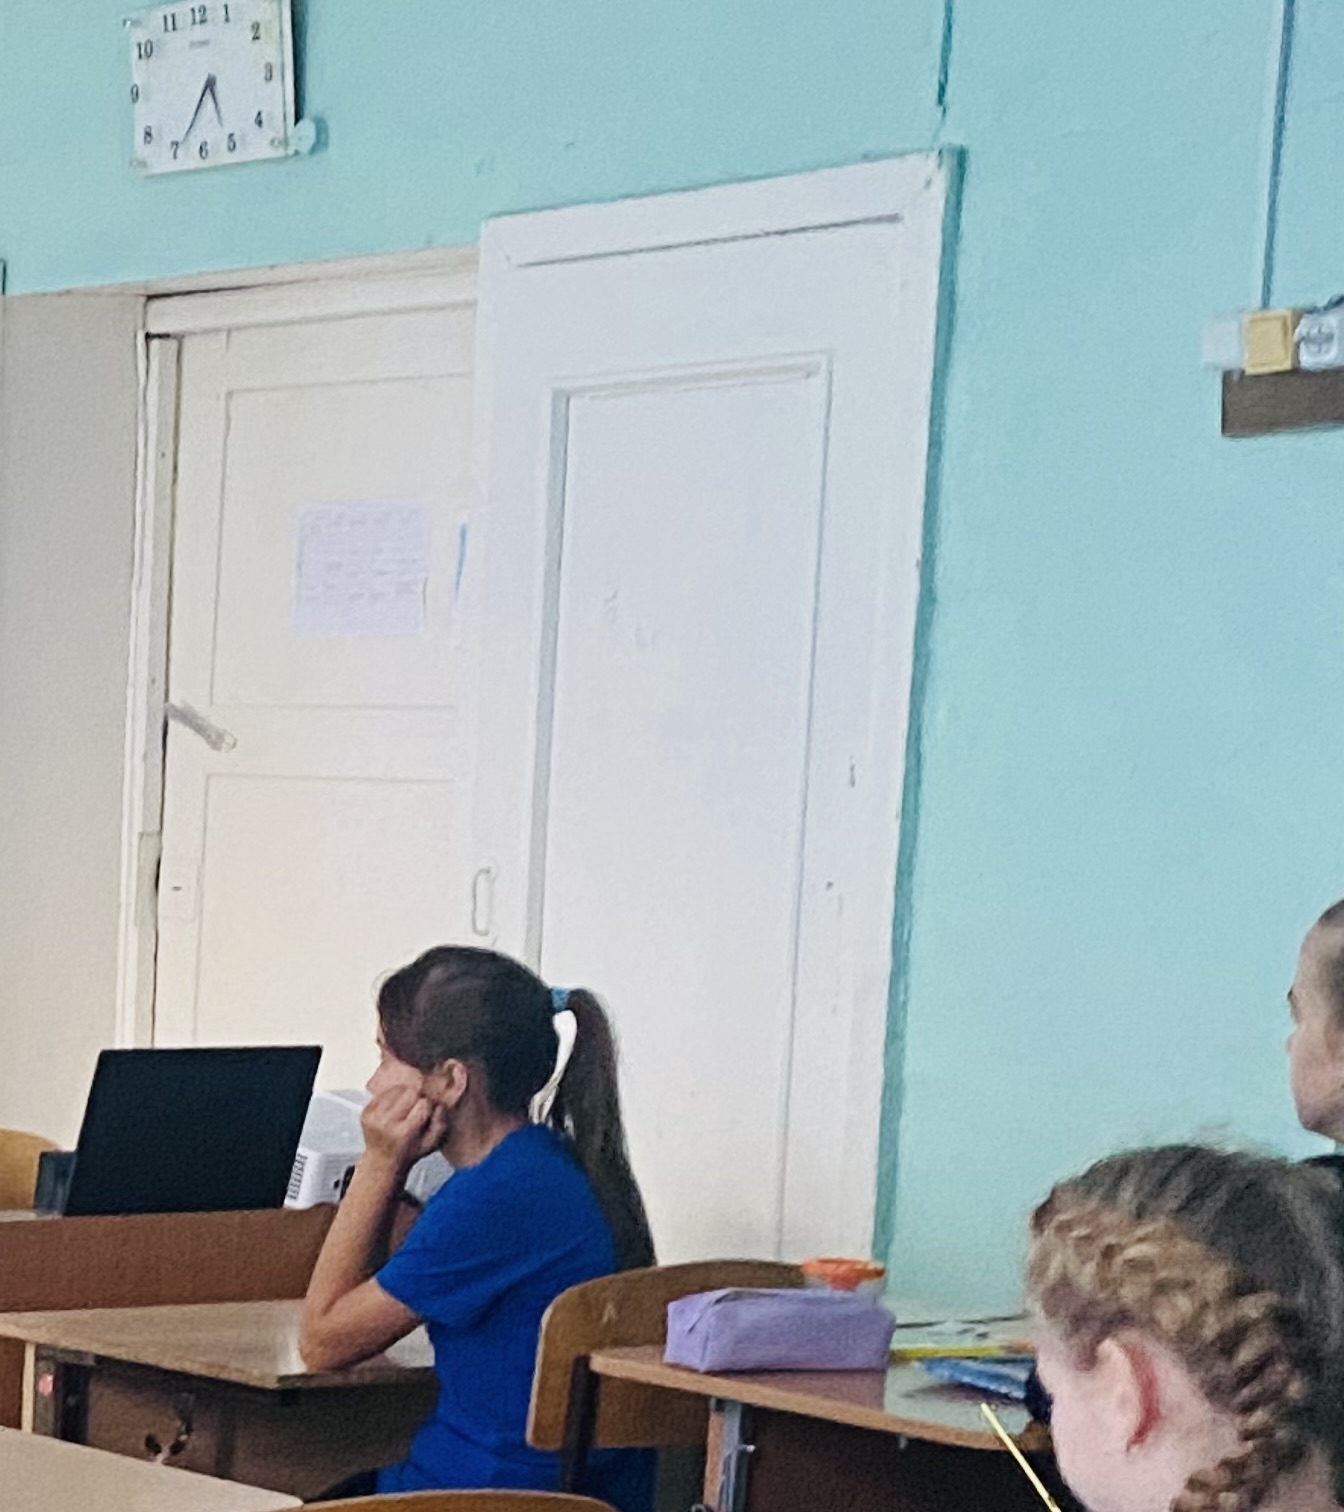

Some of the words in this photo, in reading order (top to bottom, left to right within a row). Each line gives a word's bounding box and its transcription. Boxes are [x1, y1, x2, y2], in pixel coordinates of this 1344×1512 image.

[162, 13, 177, 33] 11
[190, 5, 208, 26] 12
[223, 3, 230, 24] 1
[250, 21, 261, 41] 2
[136, 39, 154, 60] 10
[130, 83, 140, 104] 9
[254, 110, 263, 128] 4
[143, 125, 154, 145] 8
[227, 133, 237, 153] 5
[170, 141, 180, 160] 7
[199, 141, 209, 160] 6
